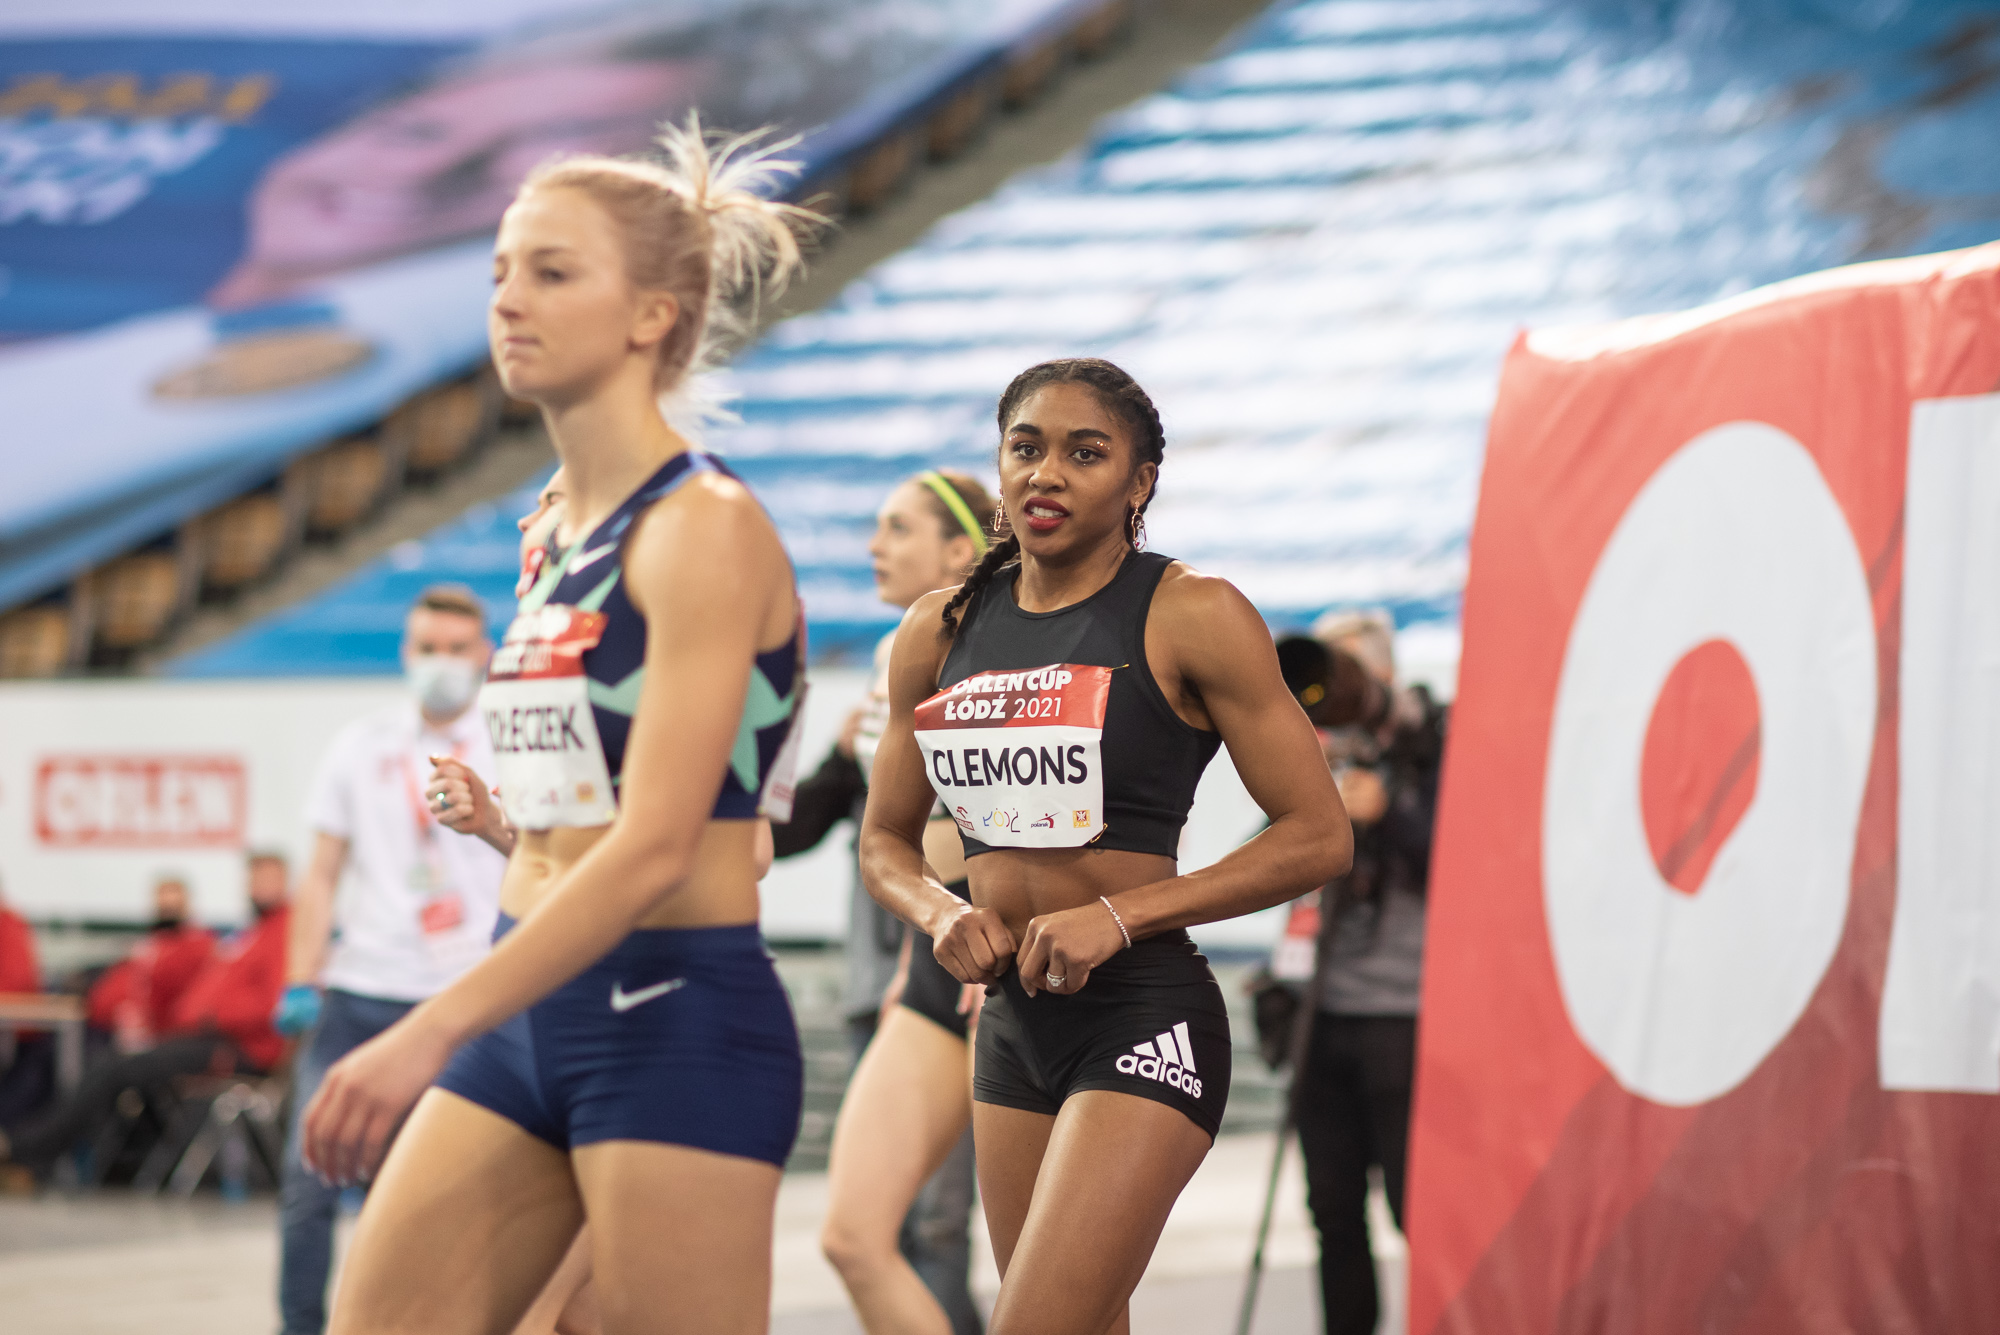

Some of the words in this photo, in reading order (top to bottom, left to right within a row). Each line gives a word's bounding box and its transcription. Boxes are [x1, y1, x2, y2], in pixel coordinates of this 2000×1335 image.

[951, 673, 1026, 694] ORLEN
[1026, 670, 1073, 691] CUP
[944, 694, 1008, 720] ŁÓDŹ
[1013, 697, 1062, 718] 2021
[932, 745, 1088, 787] CLEMONS
[1116, 1054, 1202, 1099] adidas
